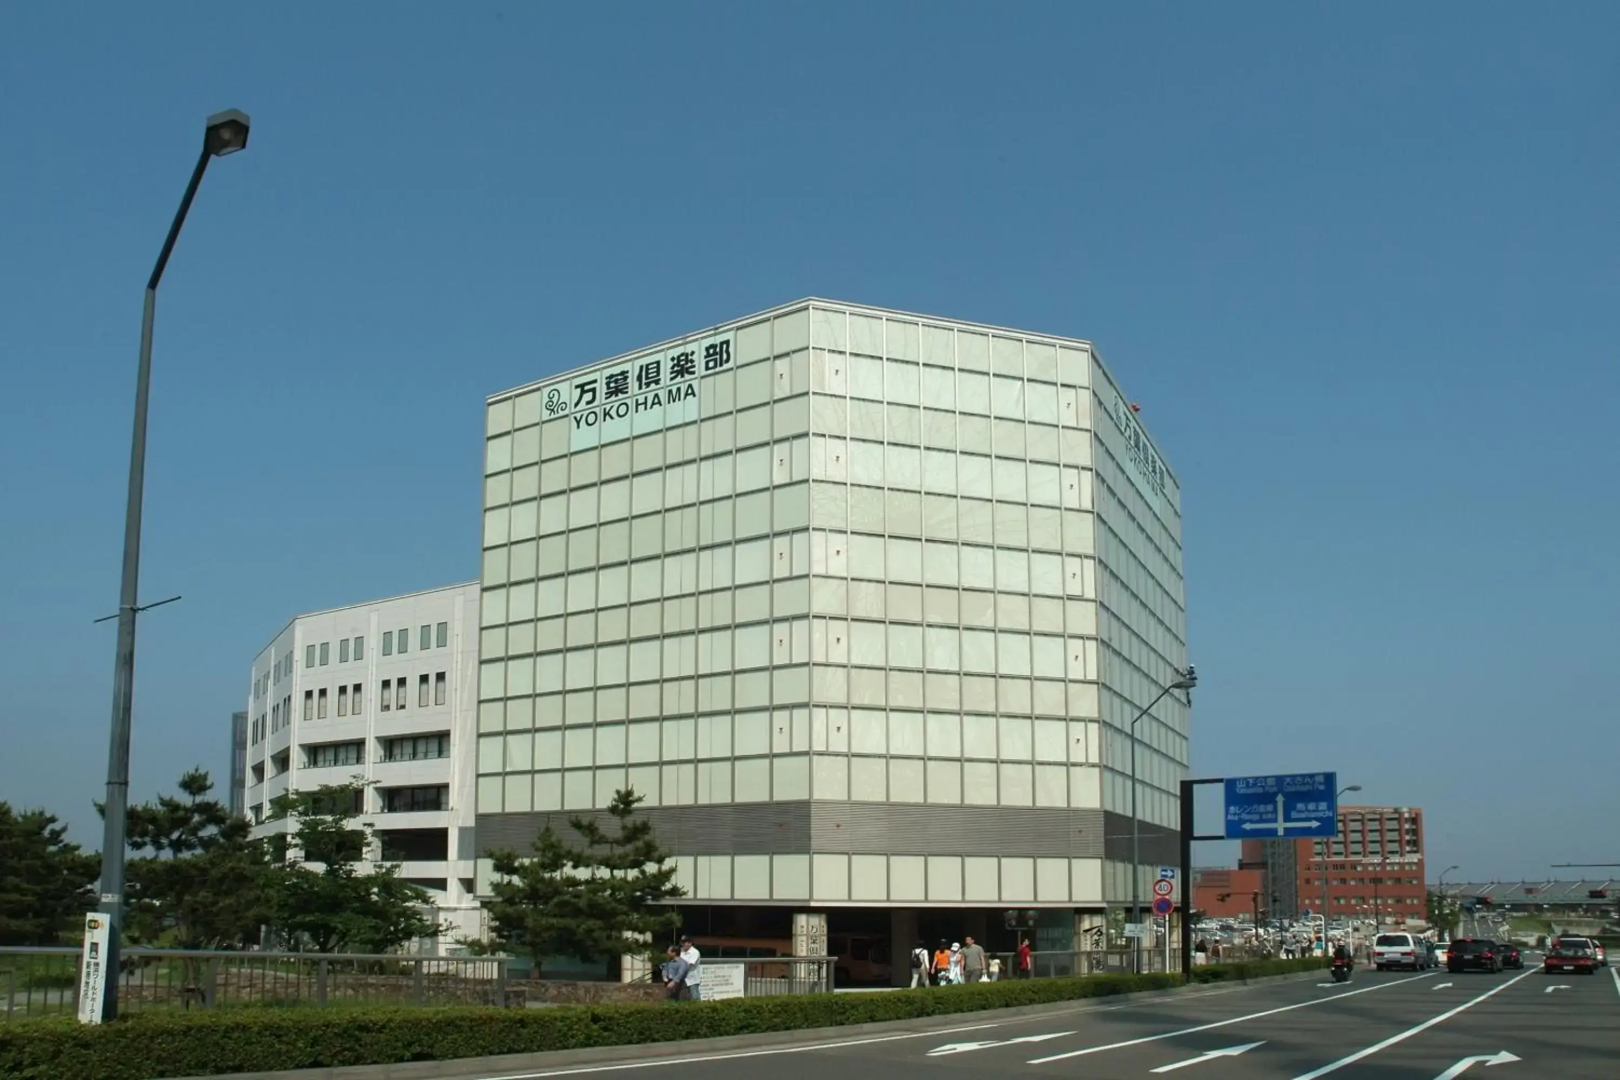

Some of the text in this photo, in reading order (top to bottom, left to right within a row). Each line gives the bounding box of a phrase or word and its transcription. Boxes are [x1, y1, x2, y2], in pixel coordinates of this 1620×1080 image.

[573, 339, 731, 409] 万葉倶楽部
[573, 383, 697, 430] YOKOHAMA
[1157, 883, 1169, 892] 40
